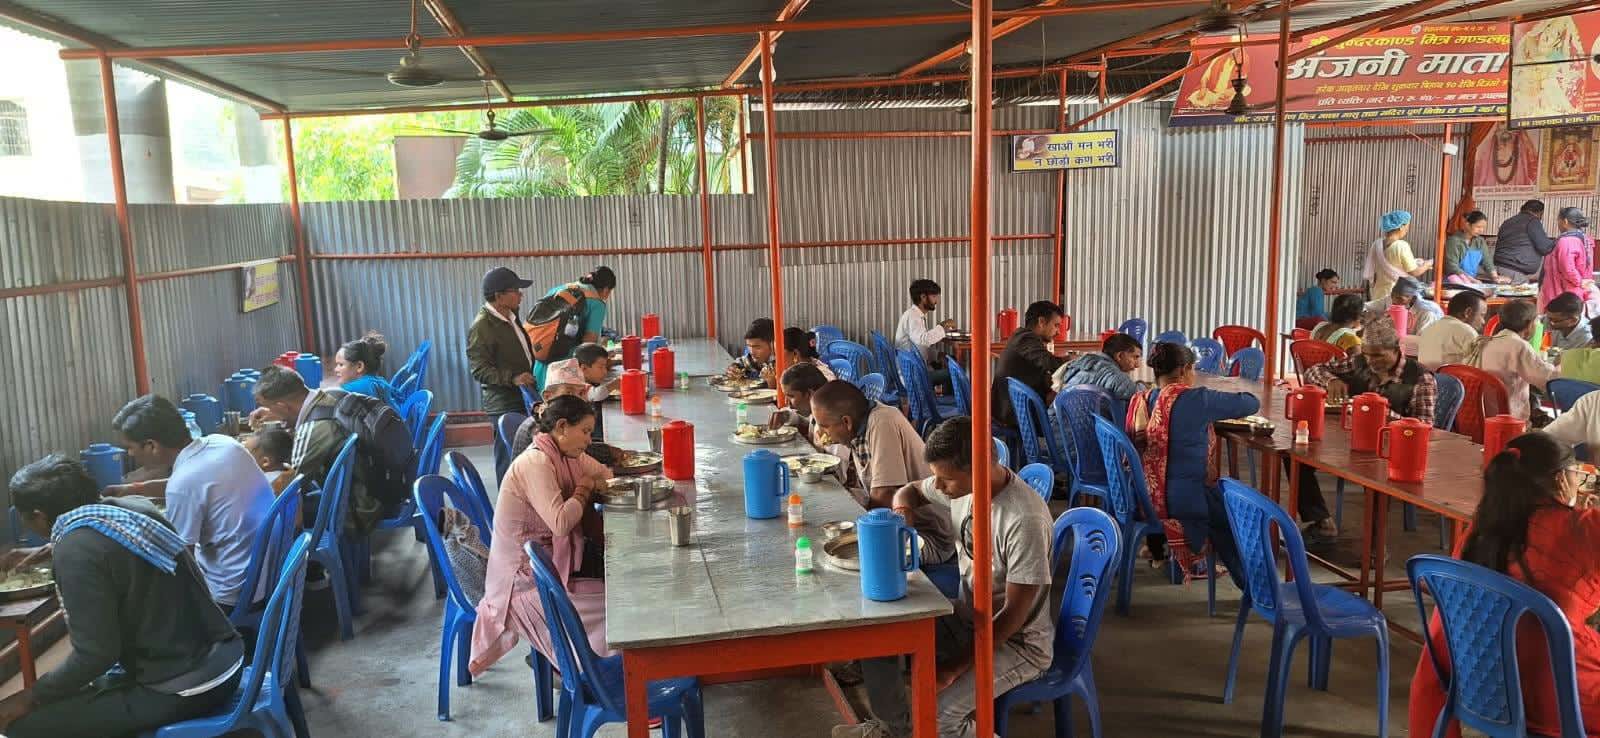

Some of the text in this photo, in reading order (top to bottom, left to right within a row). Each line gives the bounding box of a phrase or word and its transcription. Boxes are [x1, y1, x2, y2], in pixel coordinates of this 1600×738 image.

[1287, 48, 1412, 79] अंजनी
[1078, 141, 1093, 152] मन
[1098, 138, 1114, 150] भरी
[1098, 152, 1114, 164] भरी
